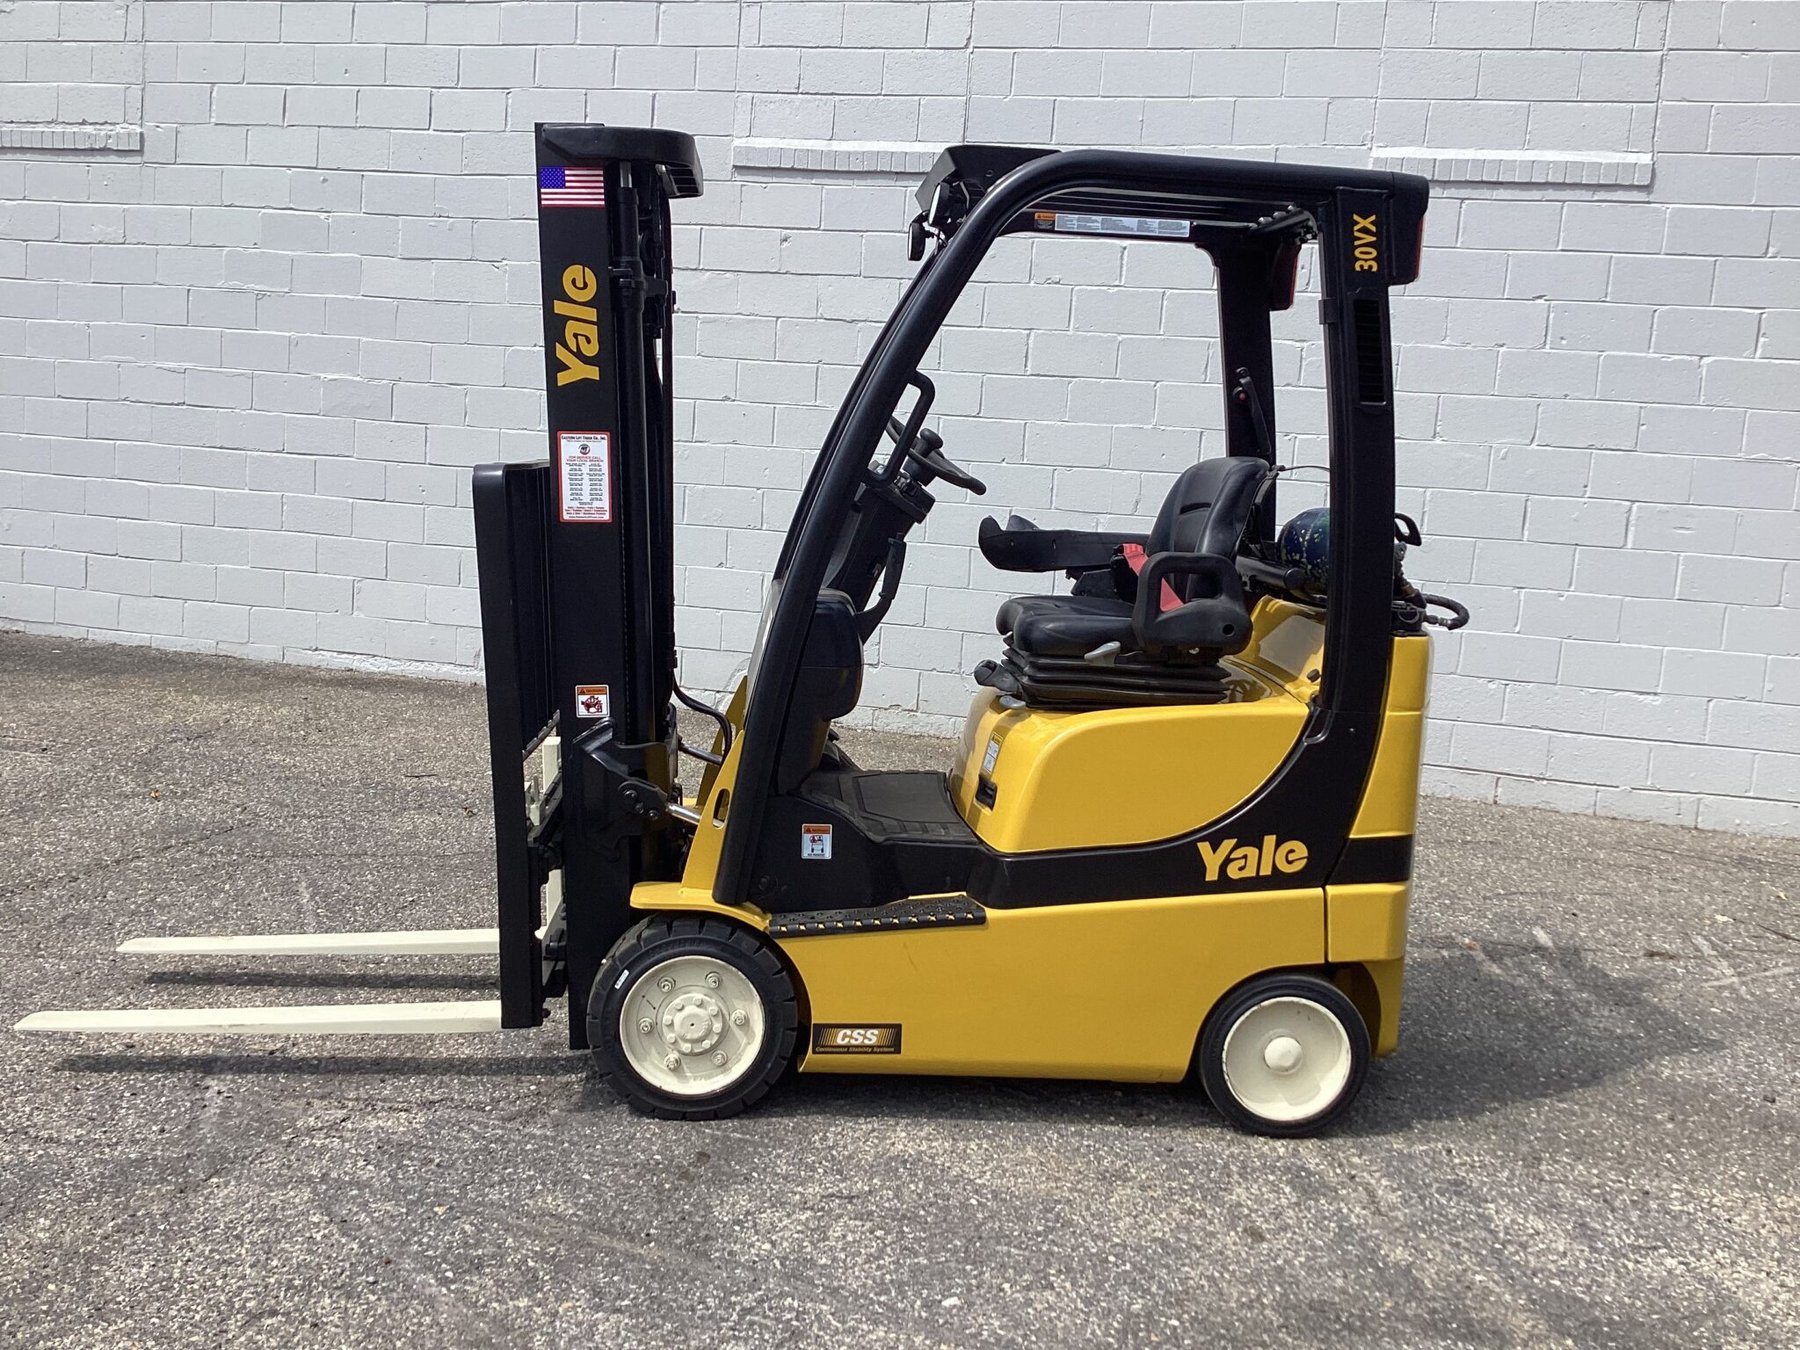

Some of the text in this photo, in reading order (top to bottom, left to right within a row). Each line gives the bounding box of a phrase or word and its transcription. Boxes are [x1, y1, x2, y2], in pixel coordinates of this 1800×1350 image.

[1352, 213, 1378, 272] 30VX
[553, 264, 600, 387] Yale
[1196, 834, 1309, 882] Yale
[836, 1028, 879, 1045] CSS
